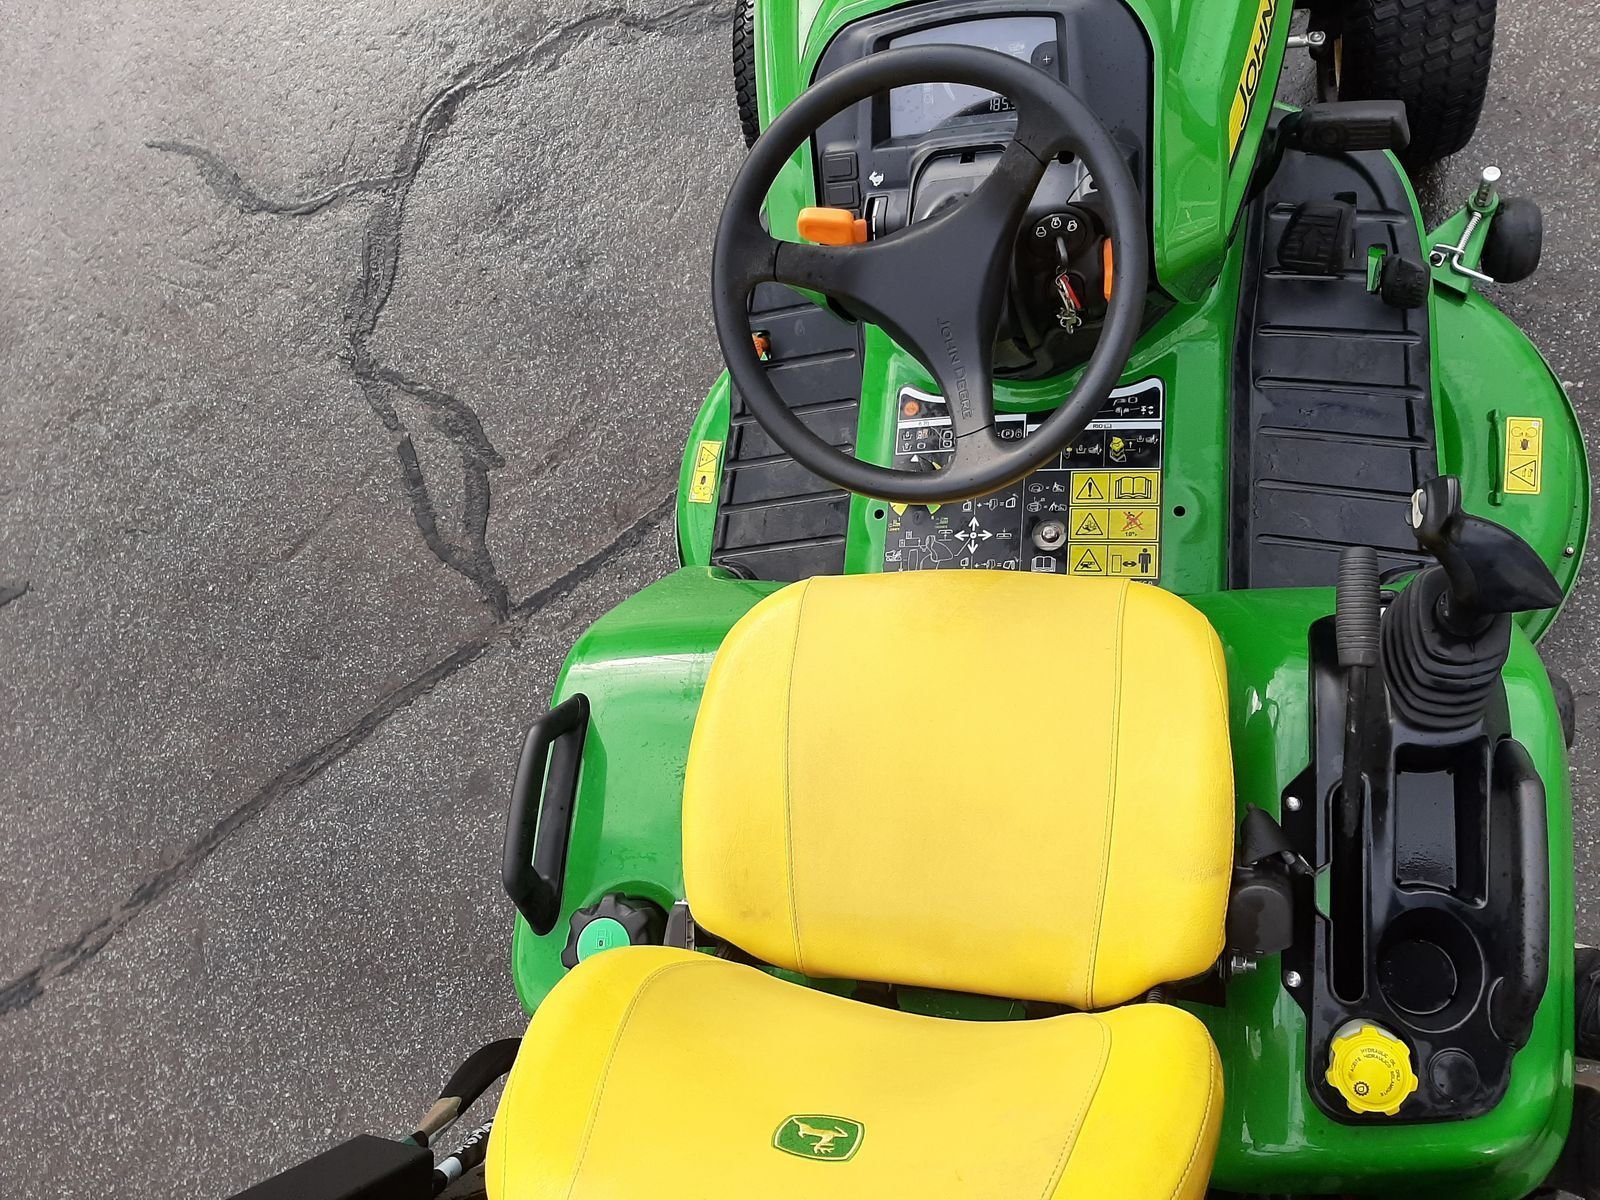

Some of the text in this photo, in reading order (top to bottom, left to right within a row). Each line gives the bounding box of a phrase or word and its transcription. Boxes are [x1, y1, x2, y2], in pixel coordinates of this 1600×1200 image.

[989, 96, 1016, 112] 185.
[937, 317, 973, 420] JOHN DEERE
[1360, 1047, 1388, 1059] HYDRAULIC
[1350, 1057, 1361, 1072] ACEITE
